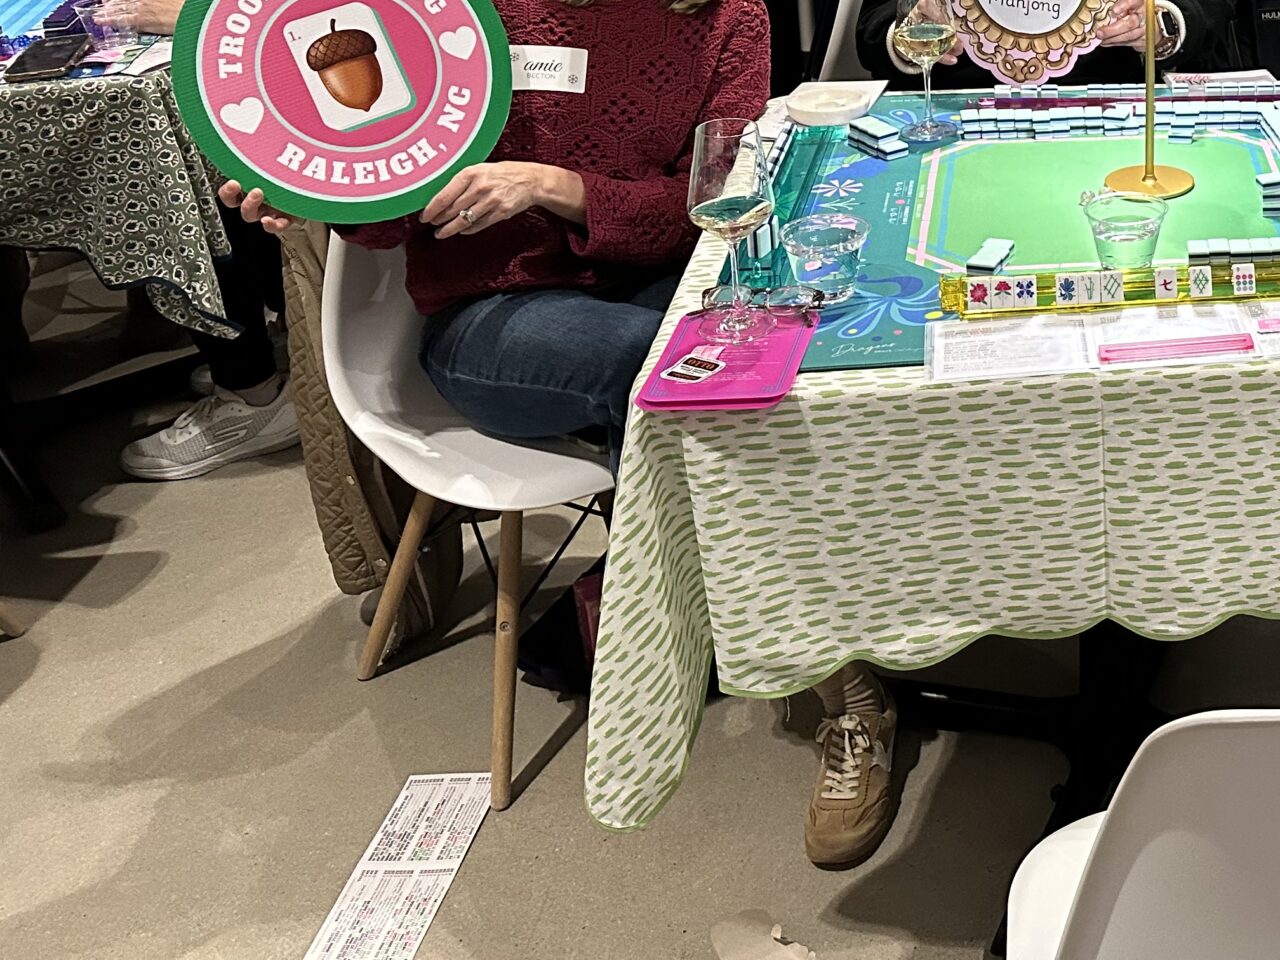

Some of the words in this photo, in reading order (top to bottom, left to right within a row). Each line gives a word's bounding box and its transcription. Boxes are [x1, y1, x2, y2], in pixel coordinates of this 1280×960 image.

[524, 59, 563, 72] amie
[276, 136, 448, 185] RALEIGH,
[438, 85, 471, 133] NC
[687, 359, 715, 370] OTTO
